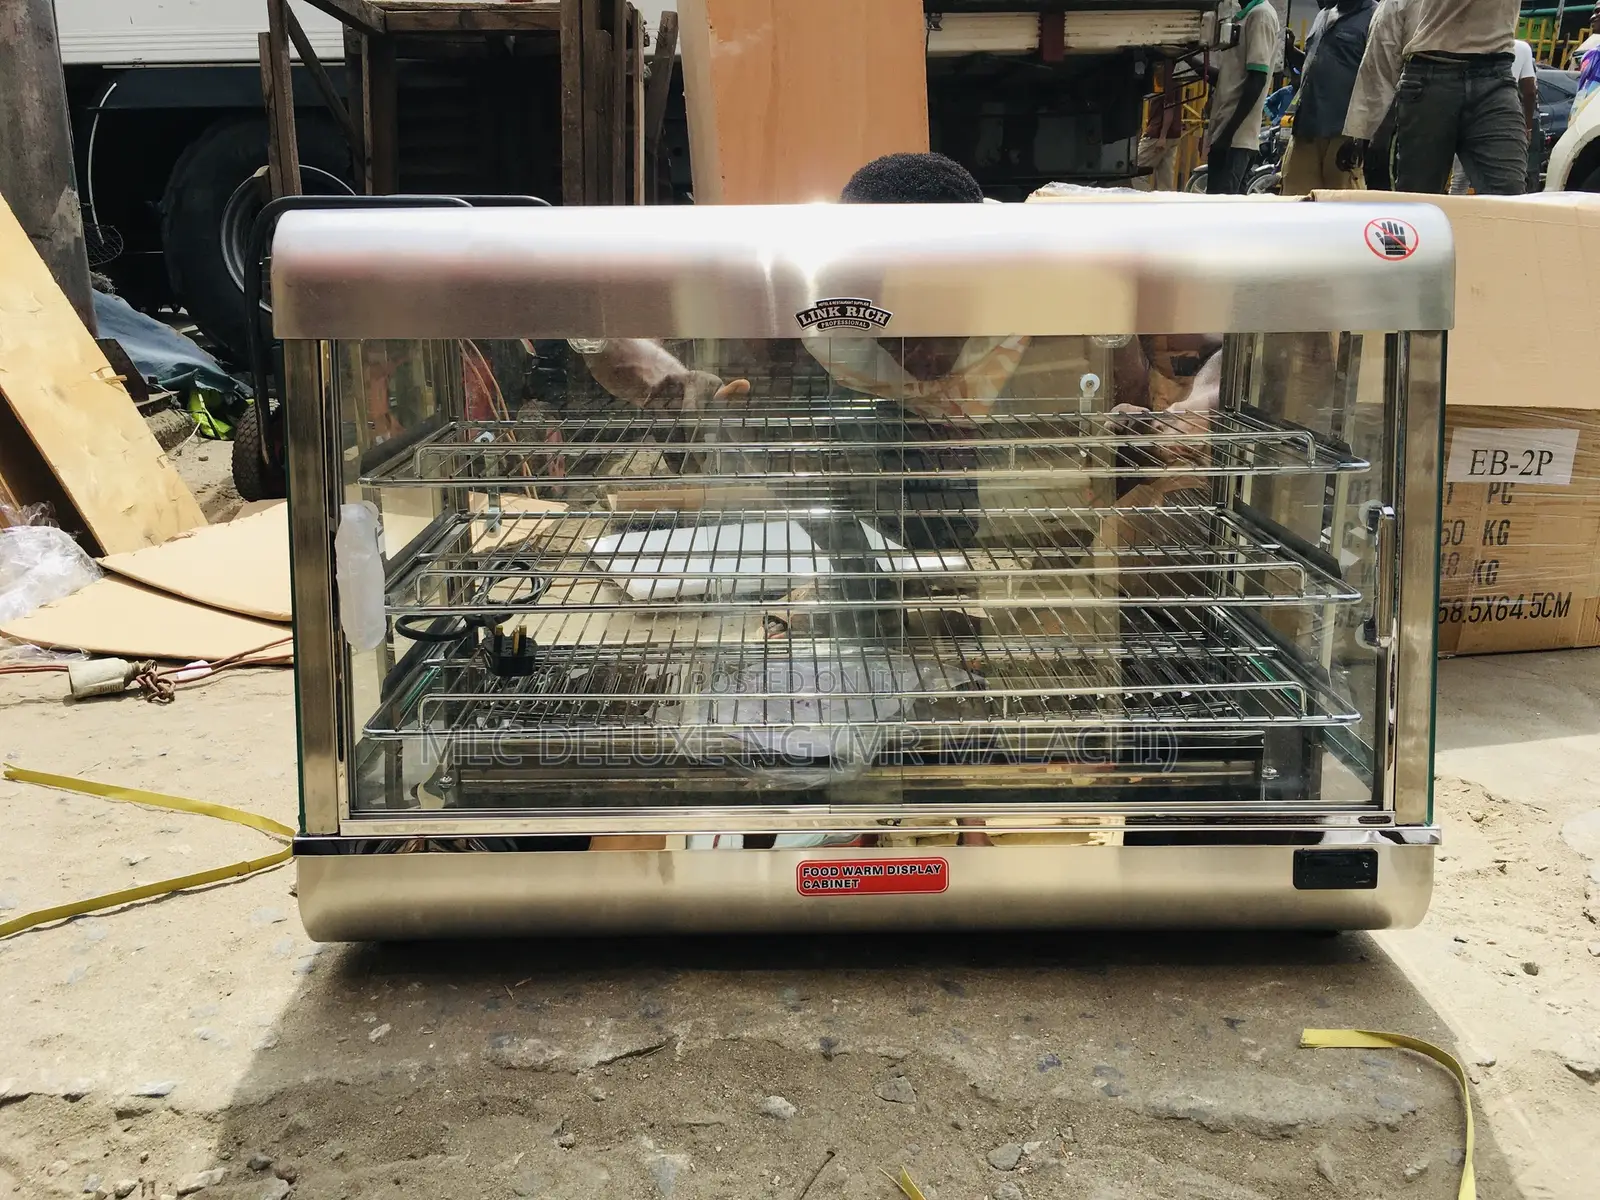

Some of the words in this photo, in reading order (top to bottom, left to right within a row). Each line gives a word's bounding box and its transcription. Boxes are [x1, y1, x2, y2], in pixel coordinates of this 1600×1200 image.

[799, 306, 841, 325] LINK
[845, 306, 888, 325] RICH
[820, 319, 867, 328] PROFESSIONAL
[1467, 449, 1554, 476] EB-2P
[1487, 482, 1515, 505] PC
[1482, 519, 1511, 546] KG
[1471, 559, 1499, 585] KG
[802, 866, 839, 877] FOOD
[841, 865, 883, 876] WARM
[887, 864, 942, 876] DISPLAY
[802, 878, 860, 889] CABINET
